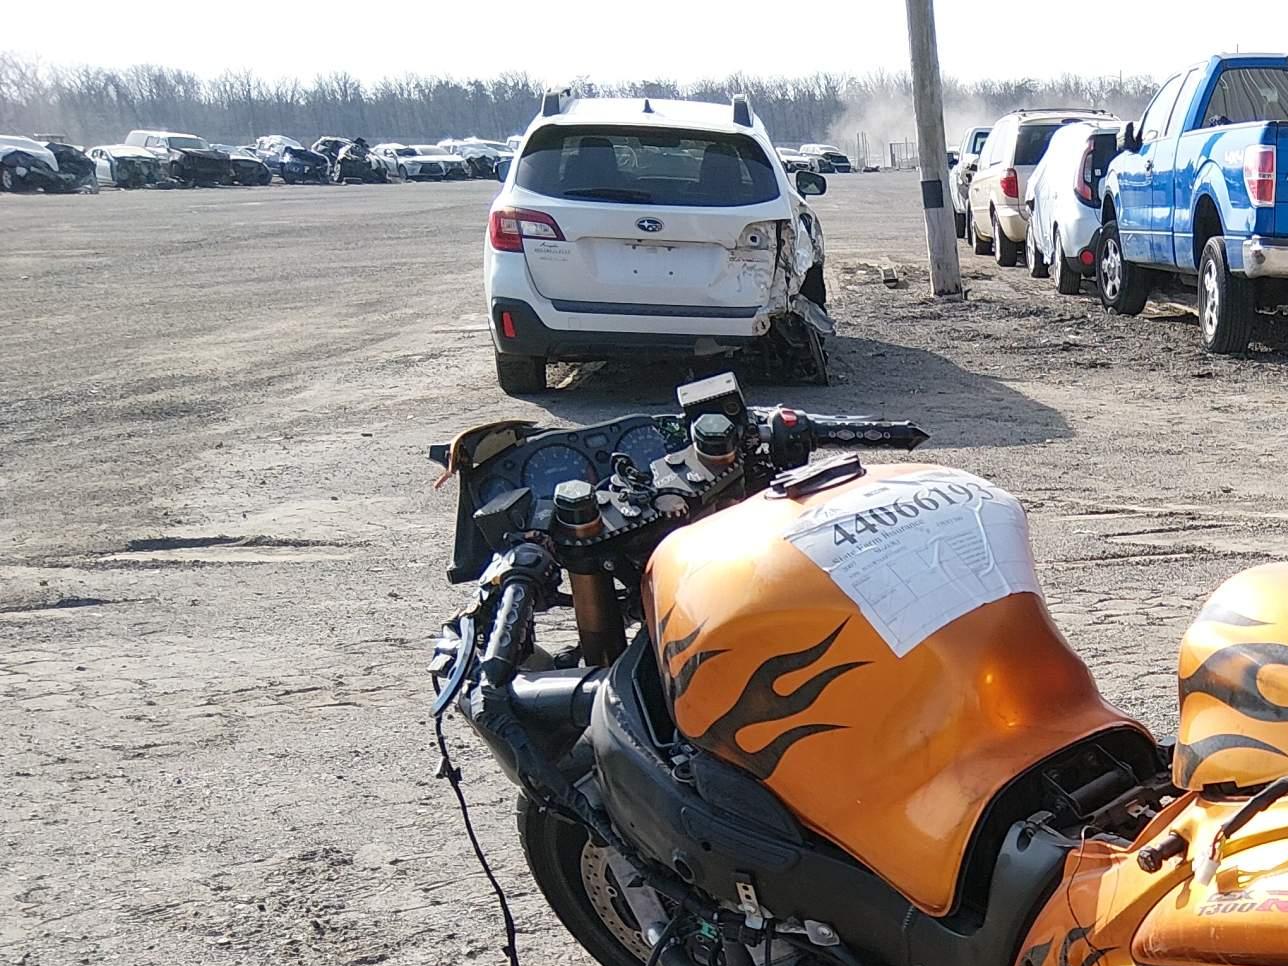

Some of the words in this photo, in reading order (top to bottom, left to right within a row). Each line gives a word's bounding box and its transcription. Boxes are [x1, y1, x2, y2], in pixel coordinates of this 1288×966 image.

[833, 483, 994, 546] 44066193
[832, 549, 856, 564] State
[857, 537, 883, 551] Farm
